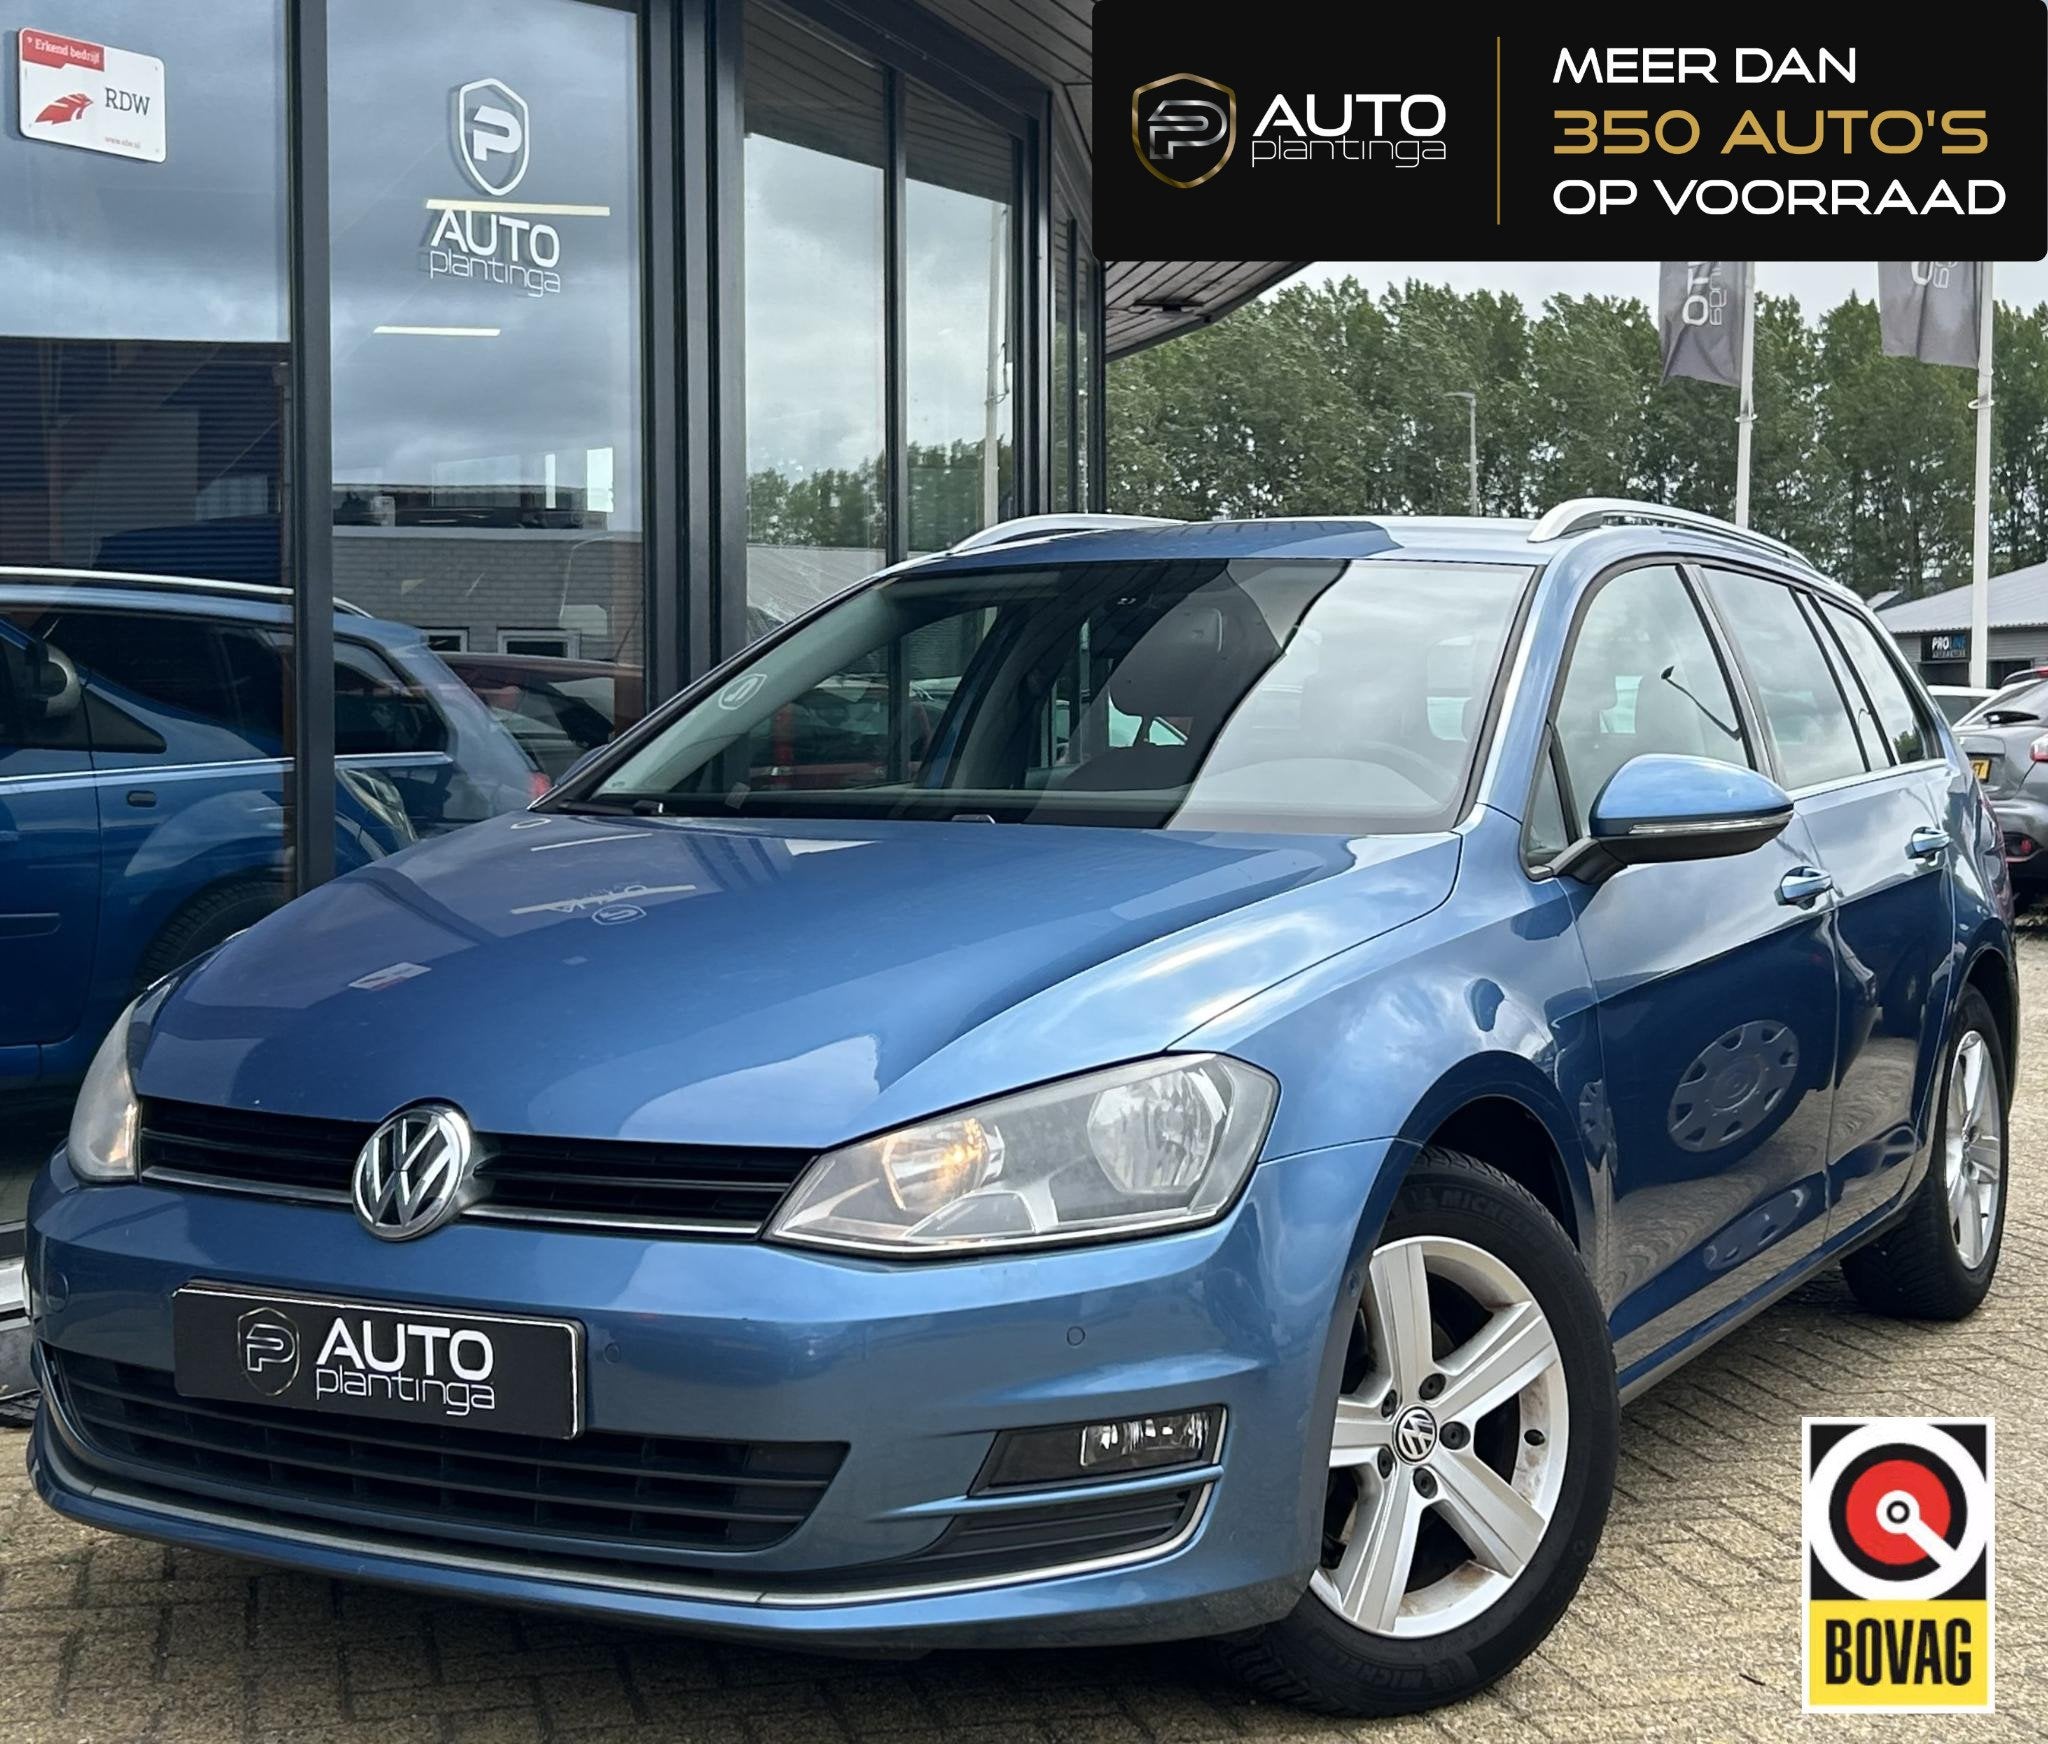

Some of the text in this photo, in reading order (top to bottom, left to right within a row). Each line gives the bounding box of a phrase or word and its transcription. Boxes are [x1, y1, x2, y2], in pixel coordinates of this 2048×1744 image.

[35, 37, 68, 57] Erkend
[105, 87, 150, 116] RDW
[430, 207, 560, 269] AUTO
[429, 248, 561, 298] plantinga
[316, 1316, 495, 1382] AUTO
[315, 1363, 496, 1417] plantinga
